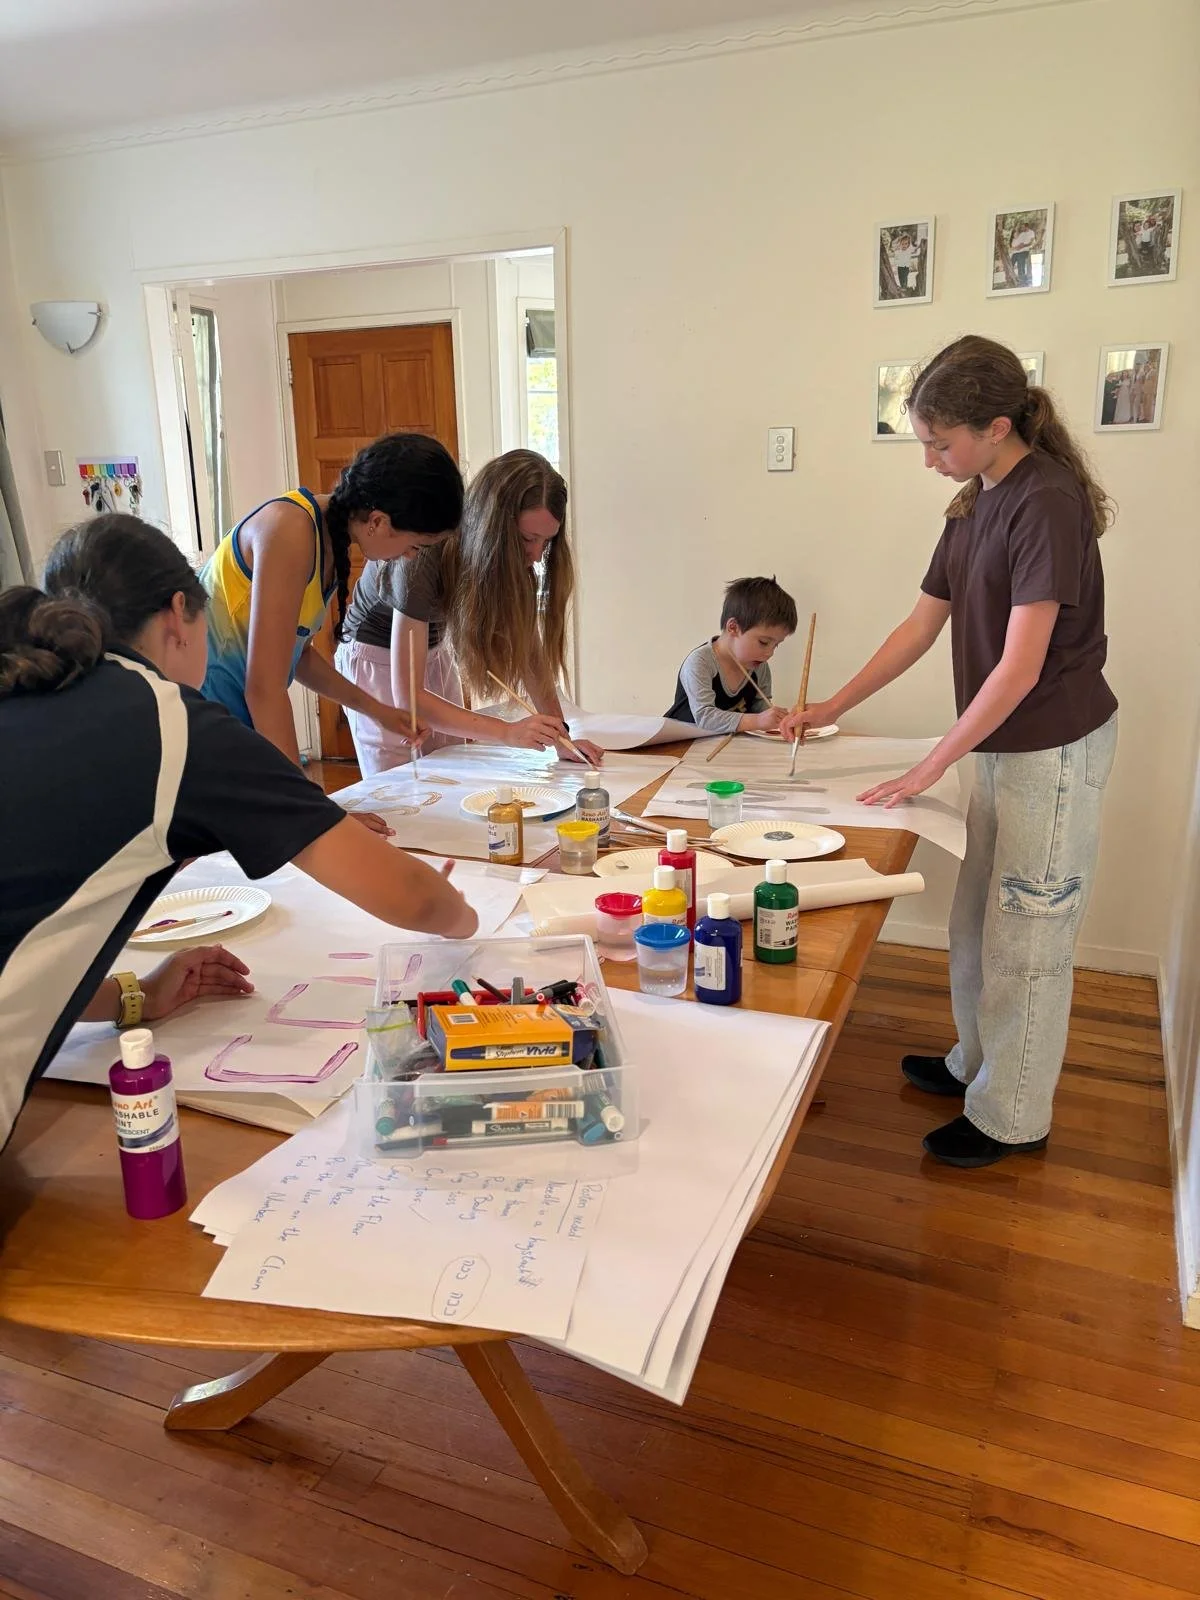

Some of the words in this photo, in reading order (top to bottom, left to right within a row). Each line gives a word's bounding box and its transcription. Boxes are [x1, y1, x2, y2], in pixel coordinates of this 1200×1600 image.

[526, 1046, 557, 1056] Vivid
[112, 1101, 130, 1110] eno
[133, 1099, 153, 1111] Art
[114, 1108, 160, 1120] ASHABLE
[115, 1118, 133, 1128] INT
[543, 1181, 567, 1206] Needle
[253, 1191, 287, 1223] Number
[290, 1210, 300, 1220] on
[278, 1227, 301, 1242] the
[252, 1255, 286, 1291] Clown
